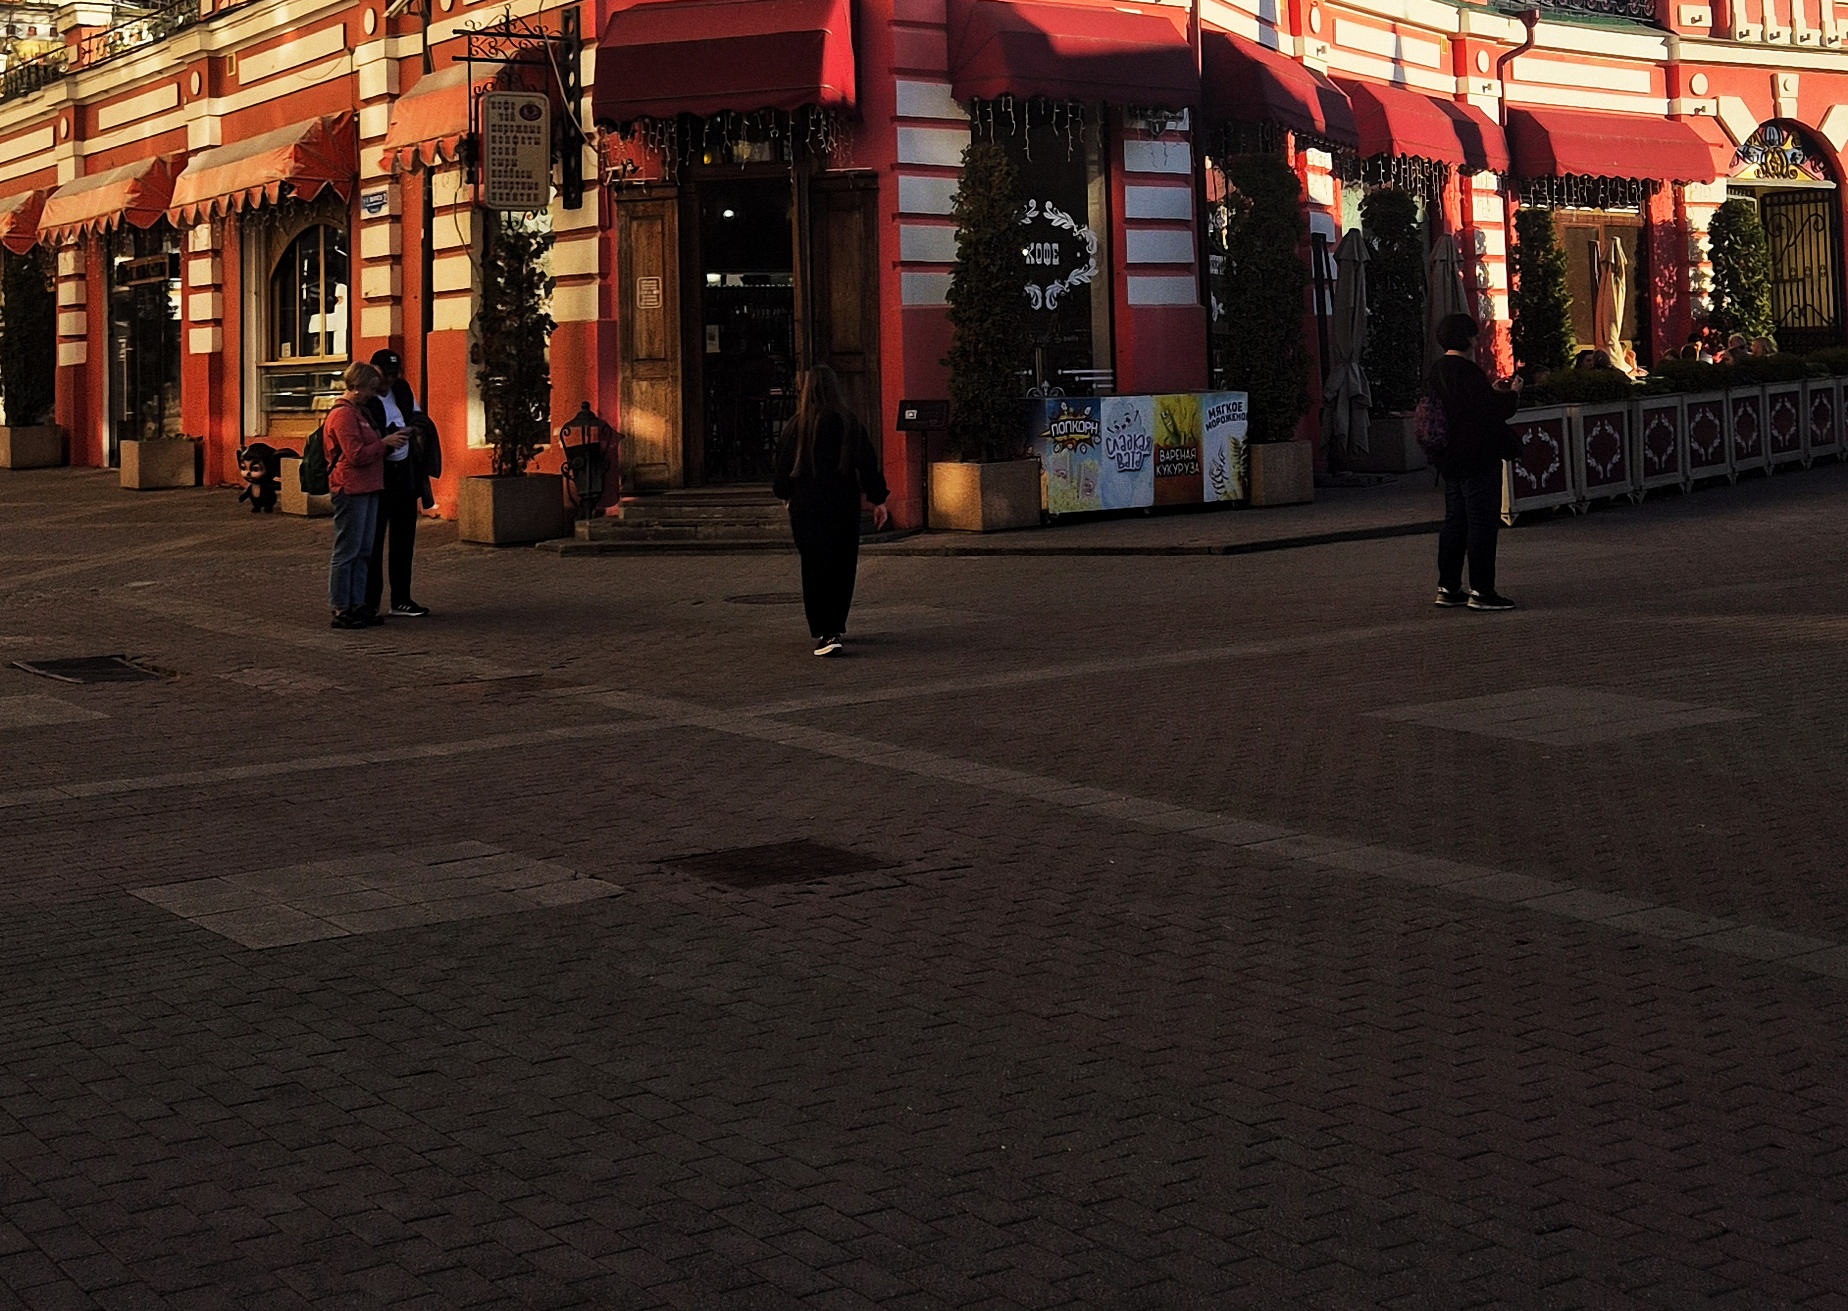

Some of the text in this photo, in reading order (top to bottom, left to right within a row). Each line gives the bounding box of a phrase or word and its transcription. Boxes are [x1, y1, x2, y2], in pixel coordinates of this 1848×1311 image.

[1025, 242, 1060, 266] КОФЕ
[1208, 401, 1243, 420] МЯГКОЕ
[1051, 420, 1099, 437] ПОПКОРН
[1159, 447, 1197, 463] ВАРЕНАЯ
[1156, 461, 1201, 477] КУКУРУЗА
